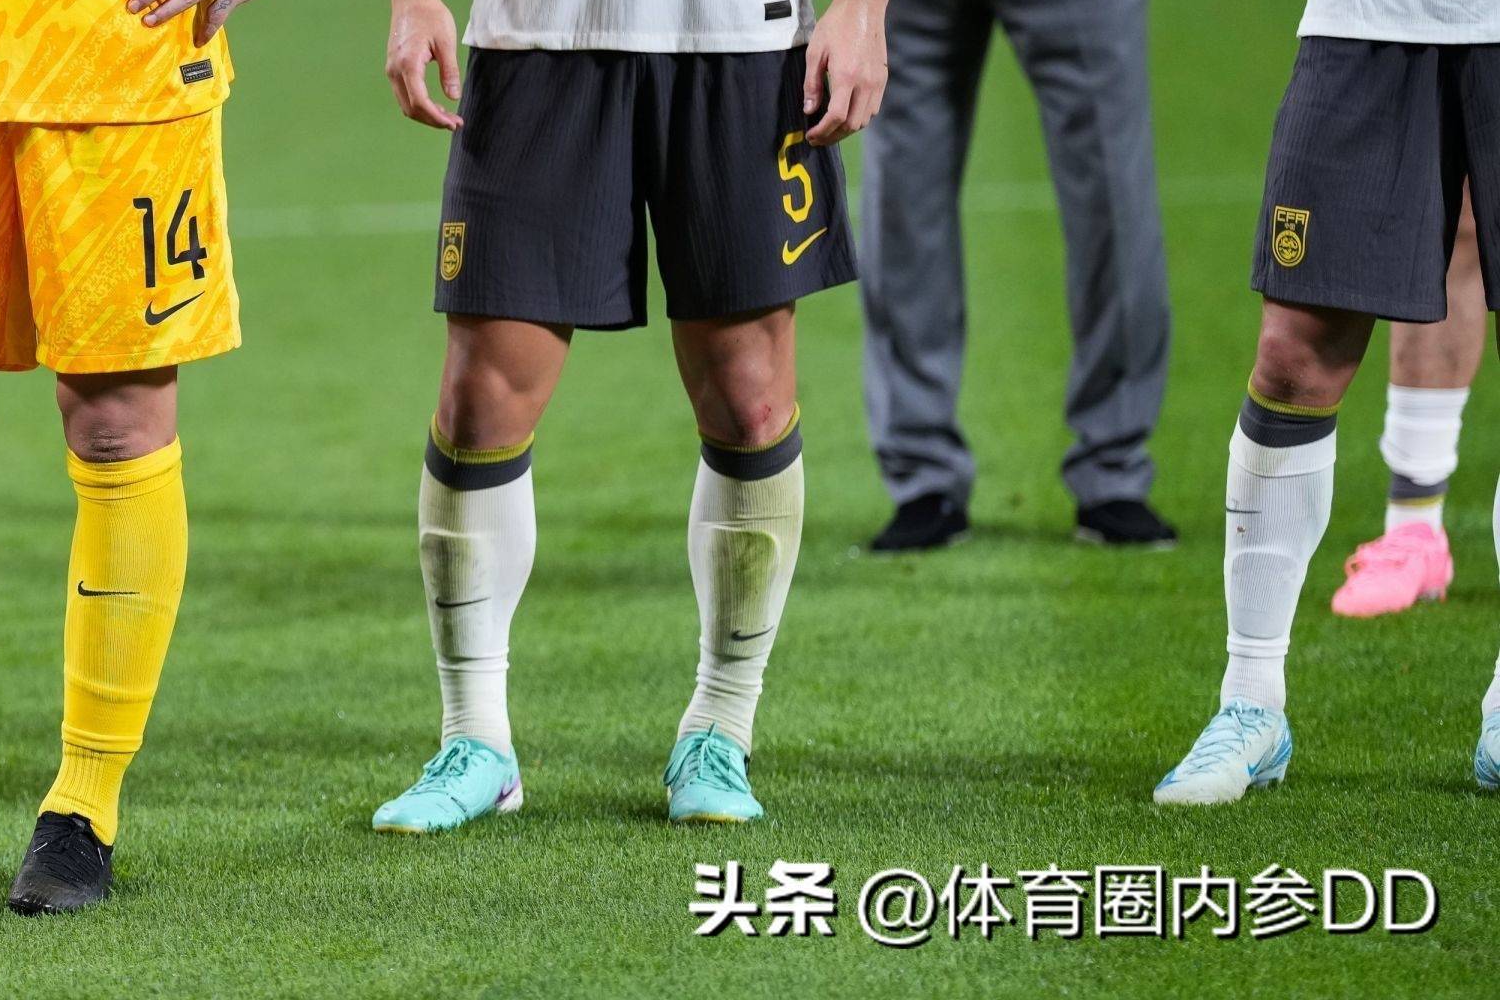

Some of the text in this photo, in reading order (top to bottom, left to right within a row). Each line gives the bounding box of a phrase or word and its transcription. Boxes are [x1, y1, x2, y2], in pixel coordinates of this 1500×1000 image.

[778, 130, 814, 224] 5
[1277, 210, 1306, 226] CFA
[132, 188, 208, 288] 14
